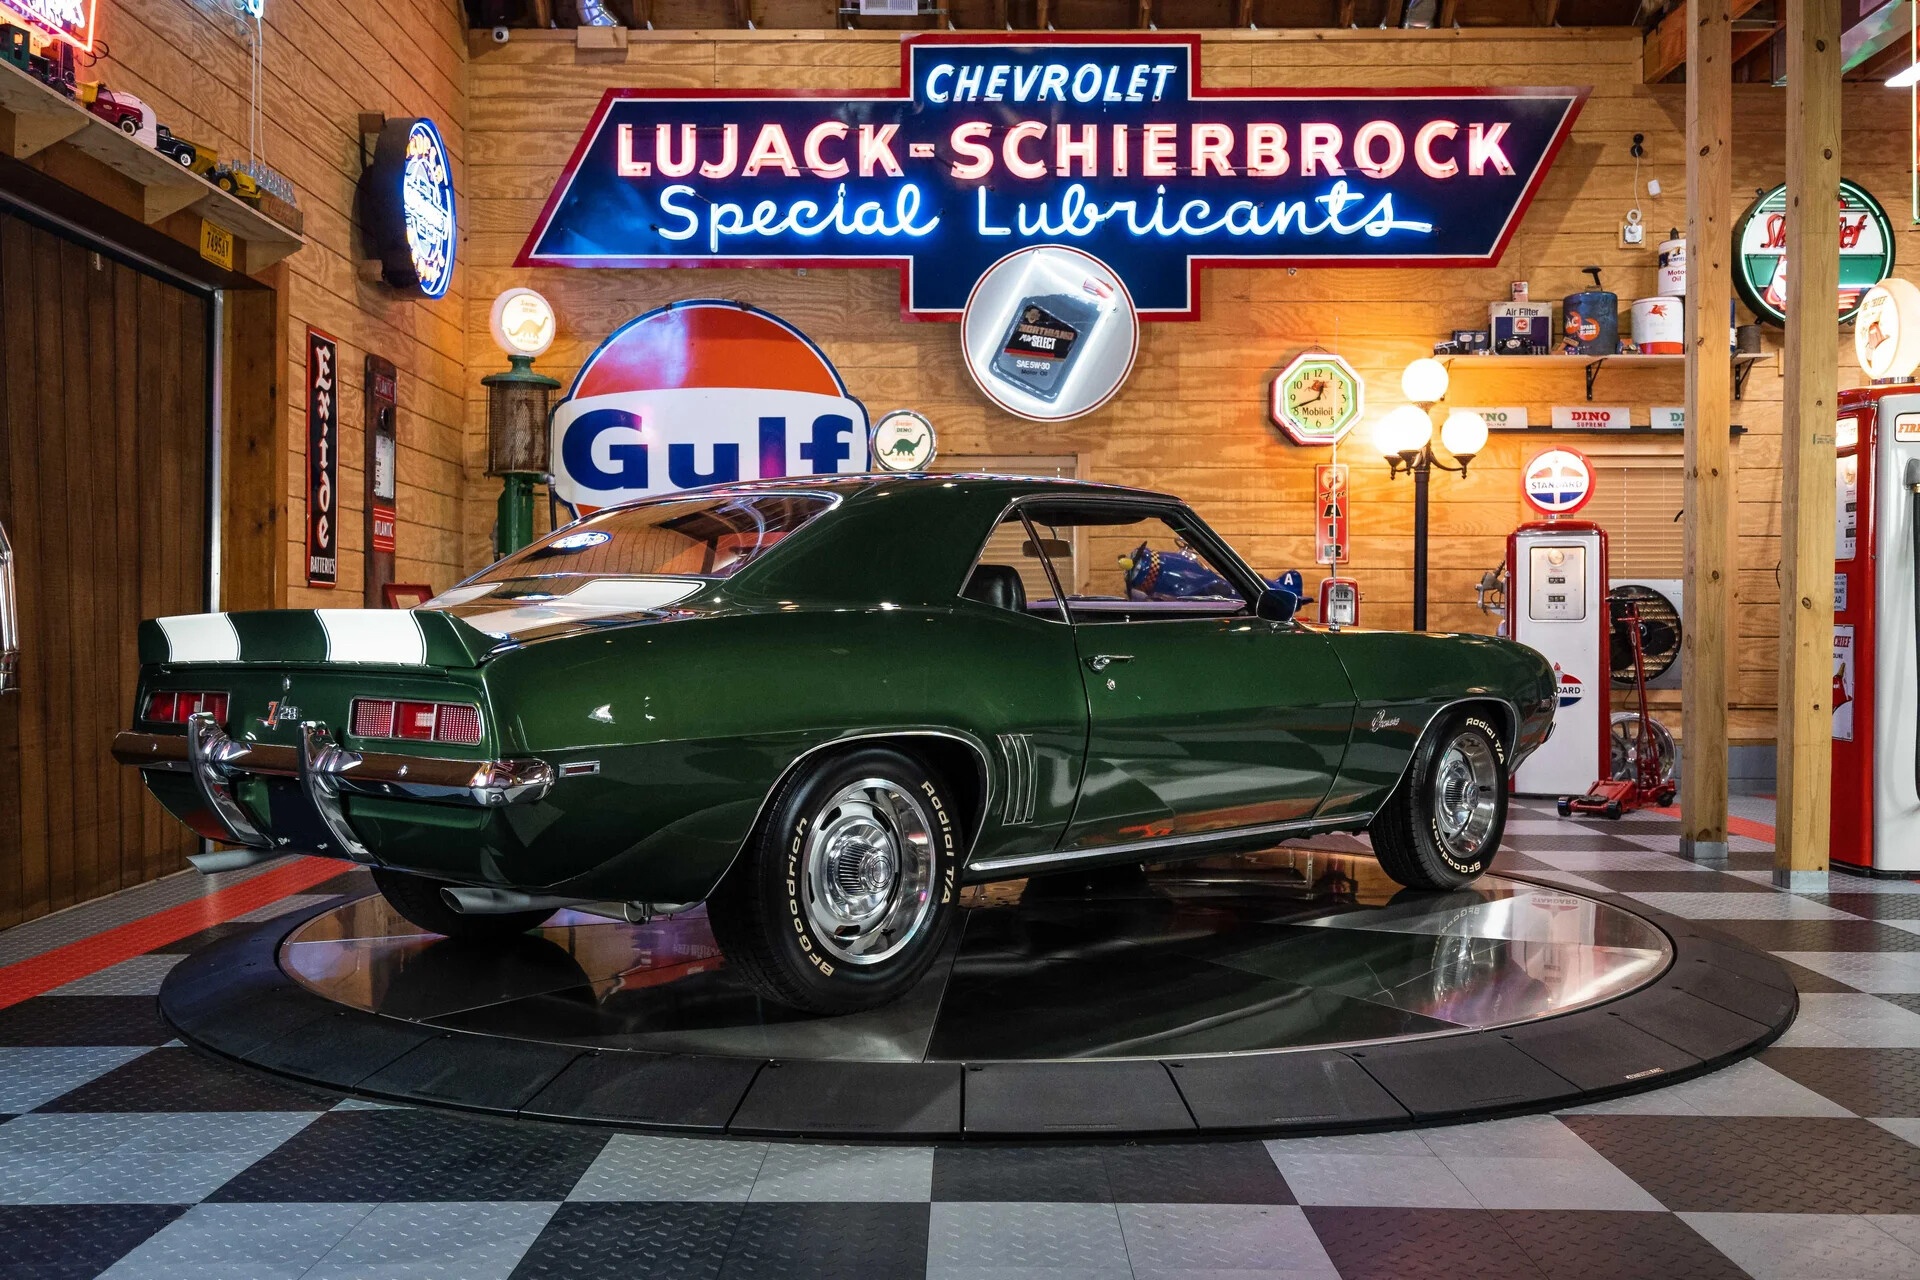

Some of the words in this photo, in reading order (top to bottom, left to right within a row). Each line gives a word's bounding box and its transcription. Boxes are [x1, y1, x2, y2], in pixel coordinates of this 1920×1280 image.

[926, 63, 1178, 103] CHEVROLET
[617, 120, 1516, 179] LUJACK-SCHIERBROCK
[658, 182, 941, 253] Special
[977, 180, 1433, 236] Lubricants
[1668, 269, 1686, 277] Moto
[1506, 308, 1517, 316] Air
[1519, 308, 1539, 316] Filter
[1517, 320, 1527, 328] AC
[1566, 316, 1579, 328] AC
[1031, 335, 1057, 350] SELECT
[1016, 359, 1030, 369] SAE
[1029, 361, 1051, 371] 5W-30
[1303, 372, 1310, 380] 11
[1314, 368, 1323, 378] 12
[1293, 381, 1303, 390] 10
[1338, 381, 1344, 390] 2
[1341, 394, 1347, 403] 3
[1293, 407, 1299, 416] 8
[1302, 407, 1334, 416] Mobiloil
[1337, 407, 1344, 416] 4
[1571, 411, 1611, 421] DINO
[1303, 417, 1308, 426] 7
[1669, 412, 1685, 422] DI
[1315, 420, 1322, 428] 6
[315, 345, 332, 549] Exide
[562, 408, 853, 490] Gulf
[374, 520, 394, 538] ATLANTIC
[310, 555, 336, 575] BATTERIES
[1284, 573, 1294, 586] A
[1557, 686, 1581, 694] DARD
[1465, 717, 1497, 740] Radial
[1494, 739, 1506, 765] T/A
[920, 780, 956, 858] Radial
[941, 867, 955, 904] T/A
[1431, 817, 1482, 874] BFGoodrich
[786, 817, 836, 977] BFGoodrich
